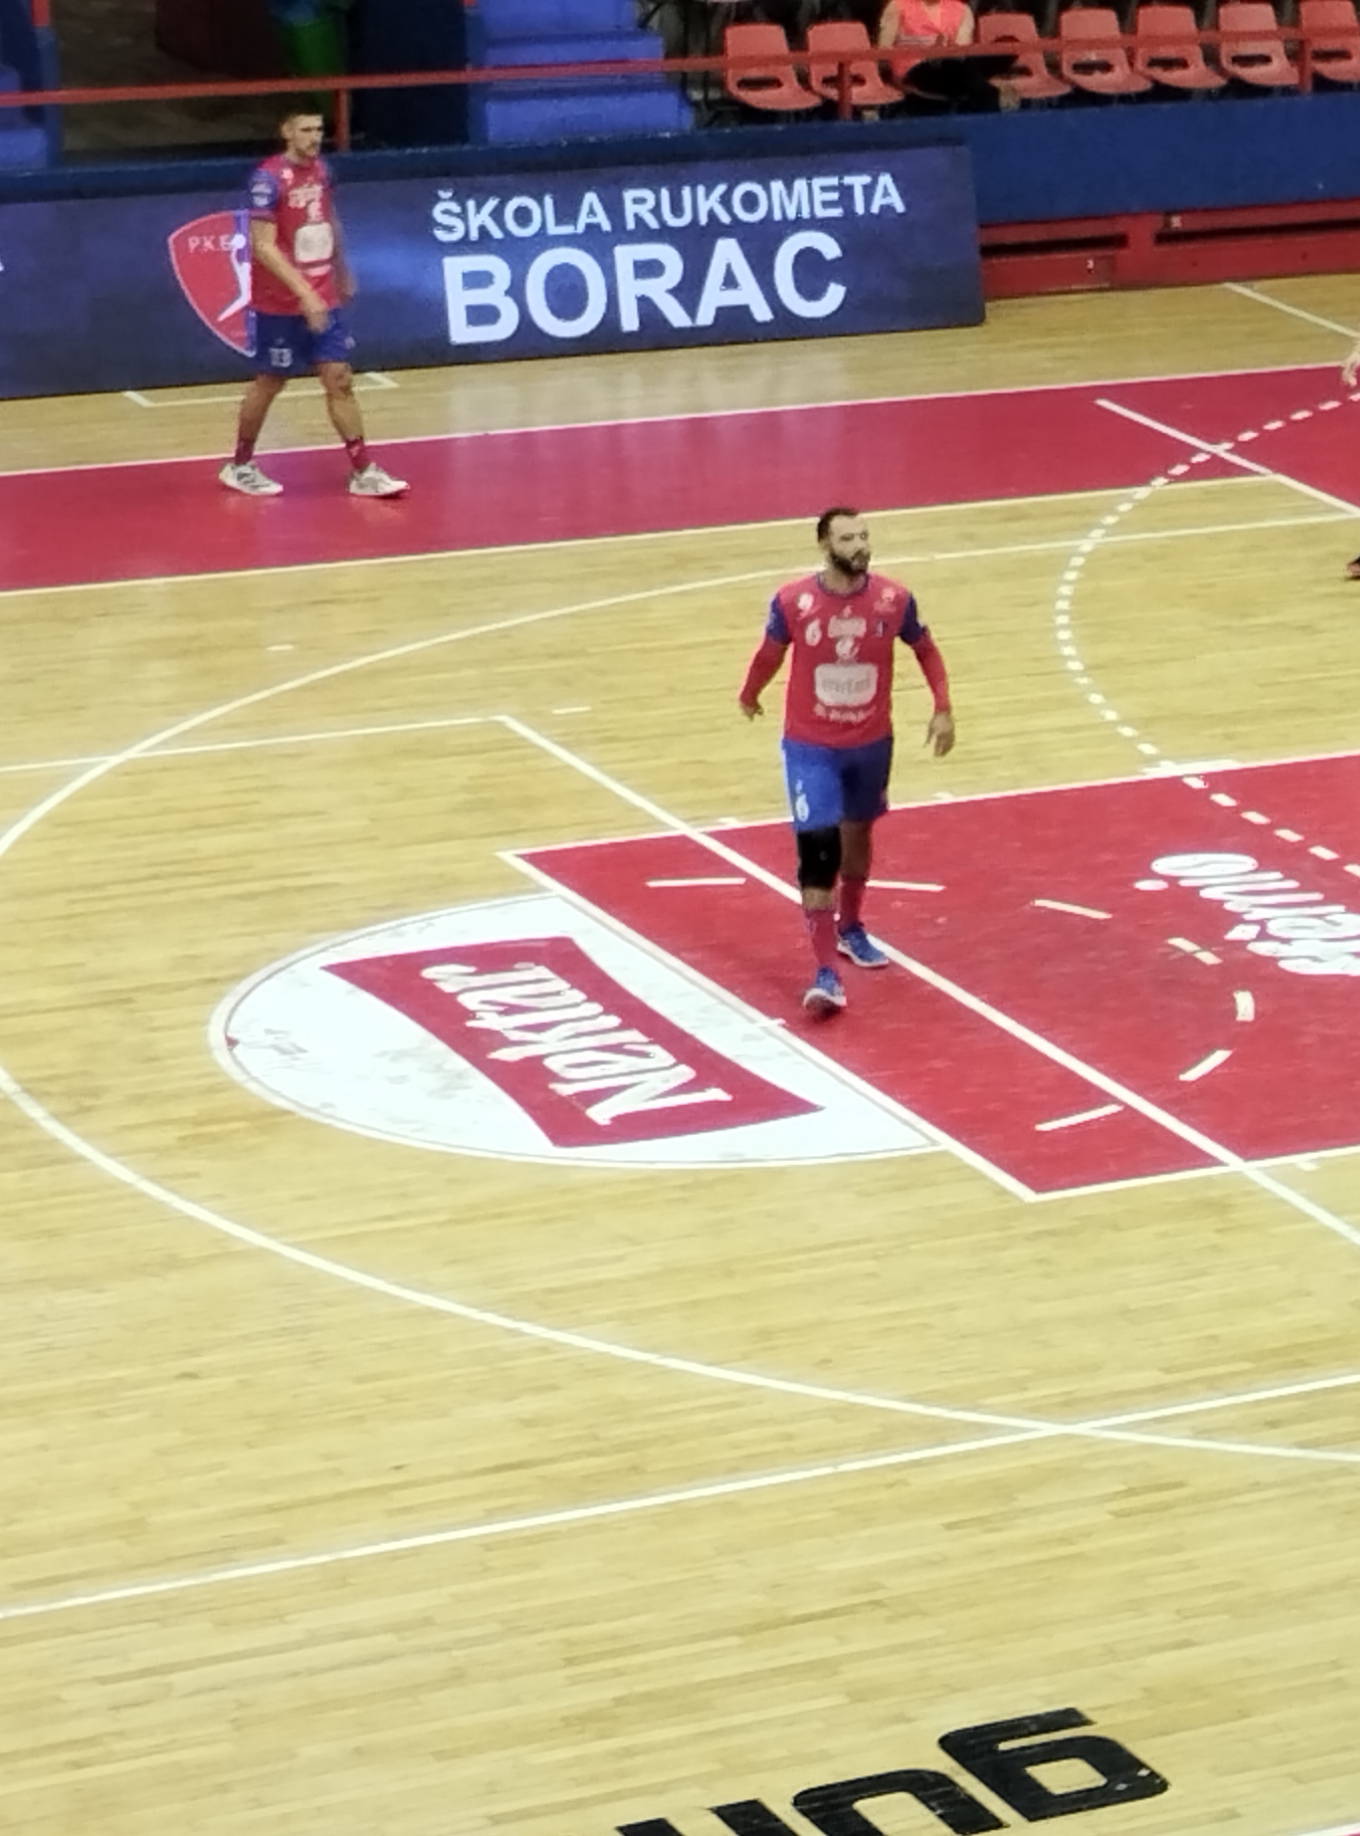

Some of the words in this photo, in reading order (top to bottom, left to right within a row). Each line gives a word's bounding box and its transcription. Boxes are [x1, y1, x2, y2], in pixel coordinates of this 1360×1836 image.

[432, 189, 612, 243] ŠKOLA
[623, 172, 907, 232] RUKOMETA
[441, 229, 849, 346] BORAC
[804, 617, 822, 647] 6
[419, 961, 734, 1126] Nektar
